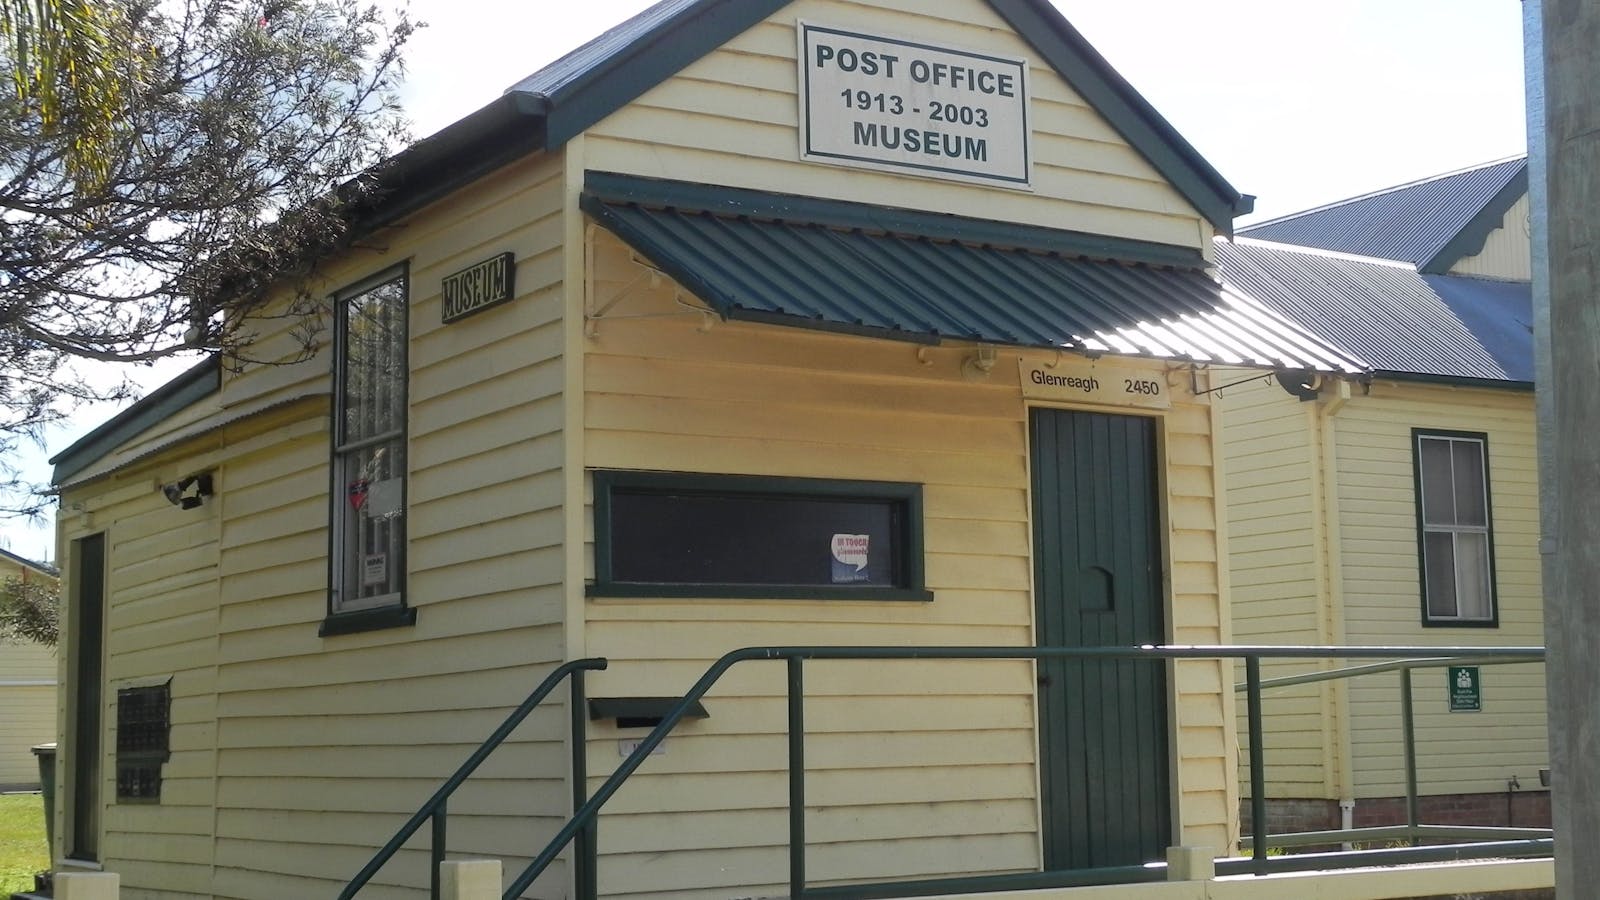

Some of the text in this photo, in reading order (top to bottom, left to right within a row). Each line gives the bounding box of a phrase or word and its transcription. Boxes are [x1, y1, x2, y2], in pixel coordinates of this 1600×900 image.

[816, 44, 1014, 98] POST OFFICE
[841, 88, 904, 115] 1913
[929, 101, 989, 128] 2003
[853, 121, 987, 162] MUSEUM
[443, 258, 505, 319] MUSEUM
[1031, 370, 1159, 396] Glenreagh 2450
